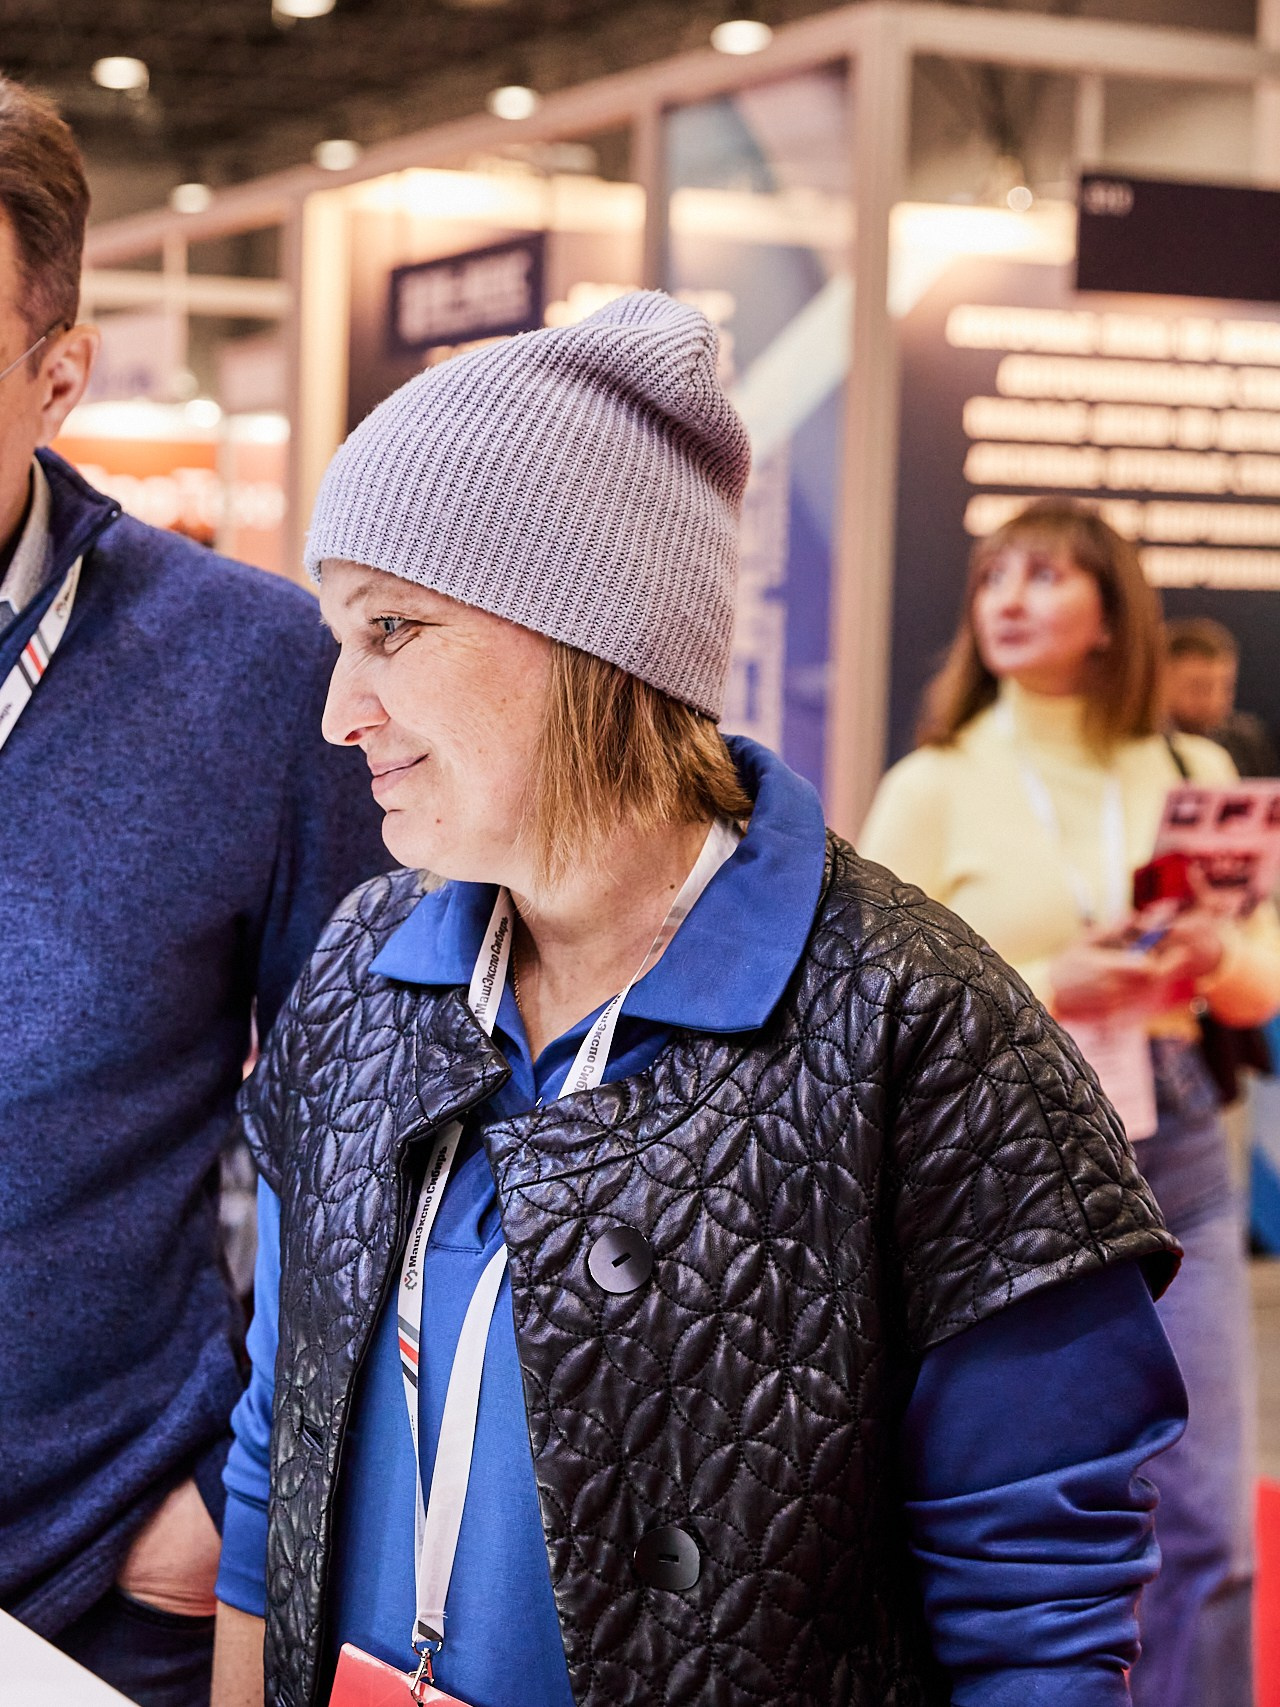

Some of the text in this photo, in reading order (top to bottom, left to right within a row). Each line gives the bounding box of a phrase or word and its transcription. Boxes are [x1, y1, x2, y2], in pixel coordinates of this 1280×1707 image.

[475, 916, 509, 1015] МашЭкспо Сибирь
[574, 1065, 595, 1092] Сиб
[408, 1146, 448, 1268] МашЭкспо Сибирь
